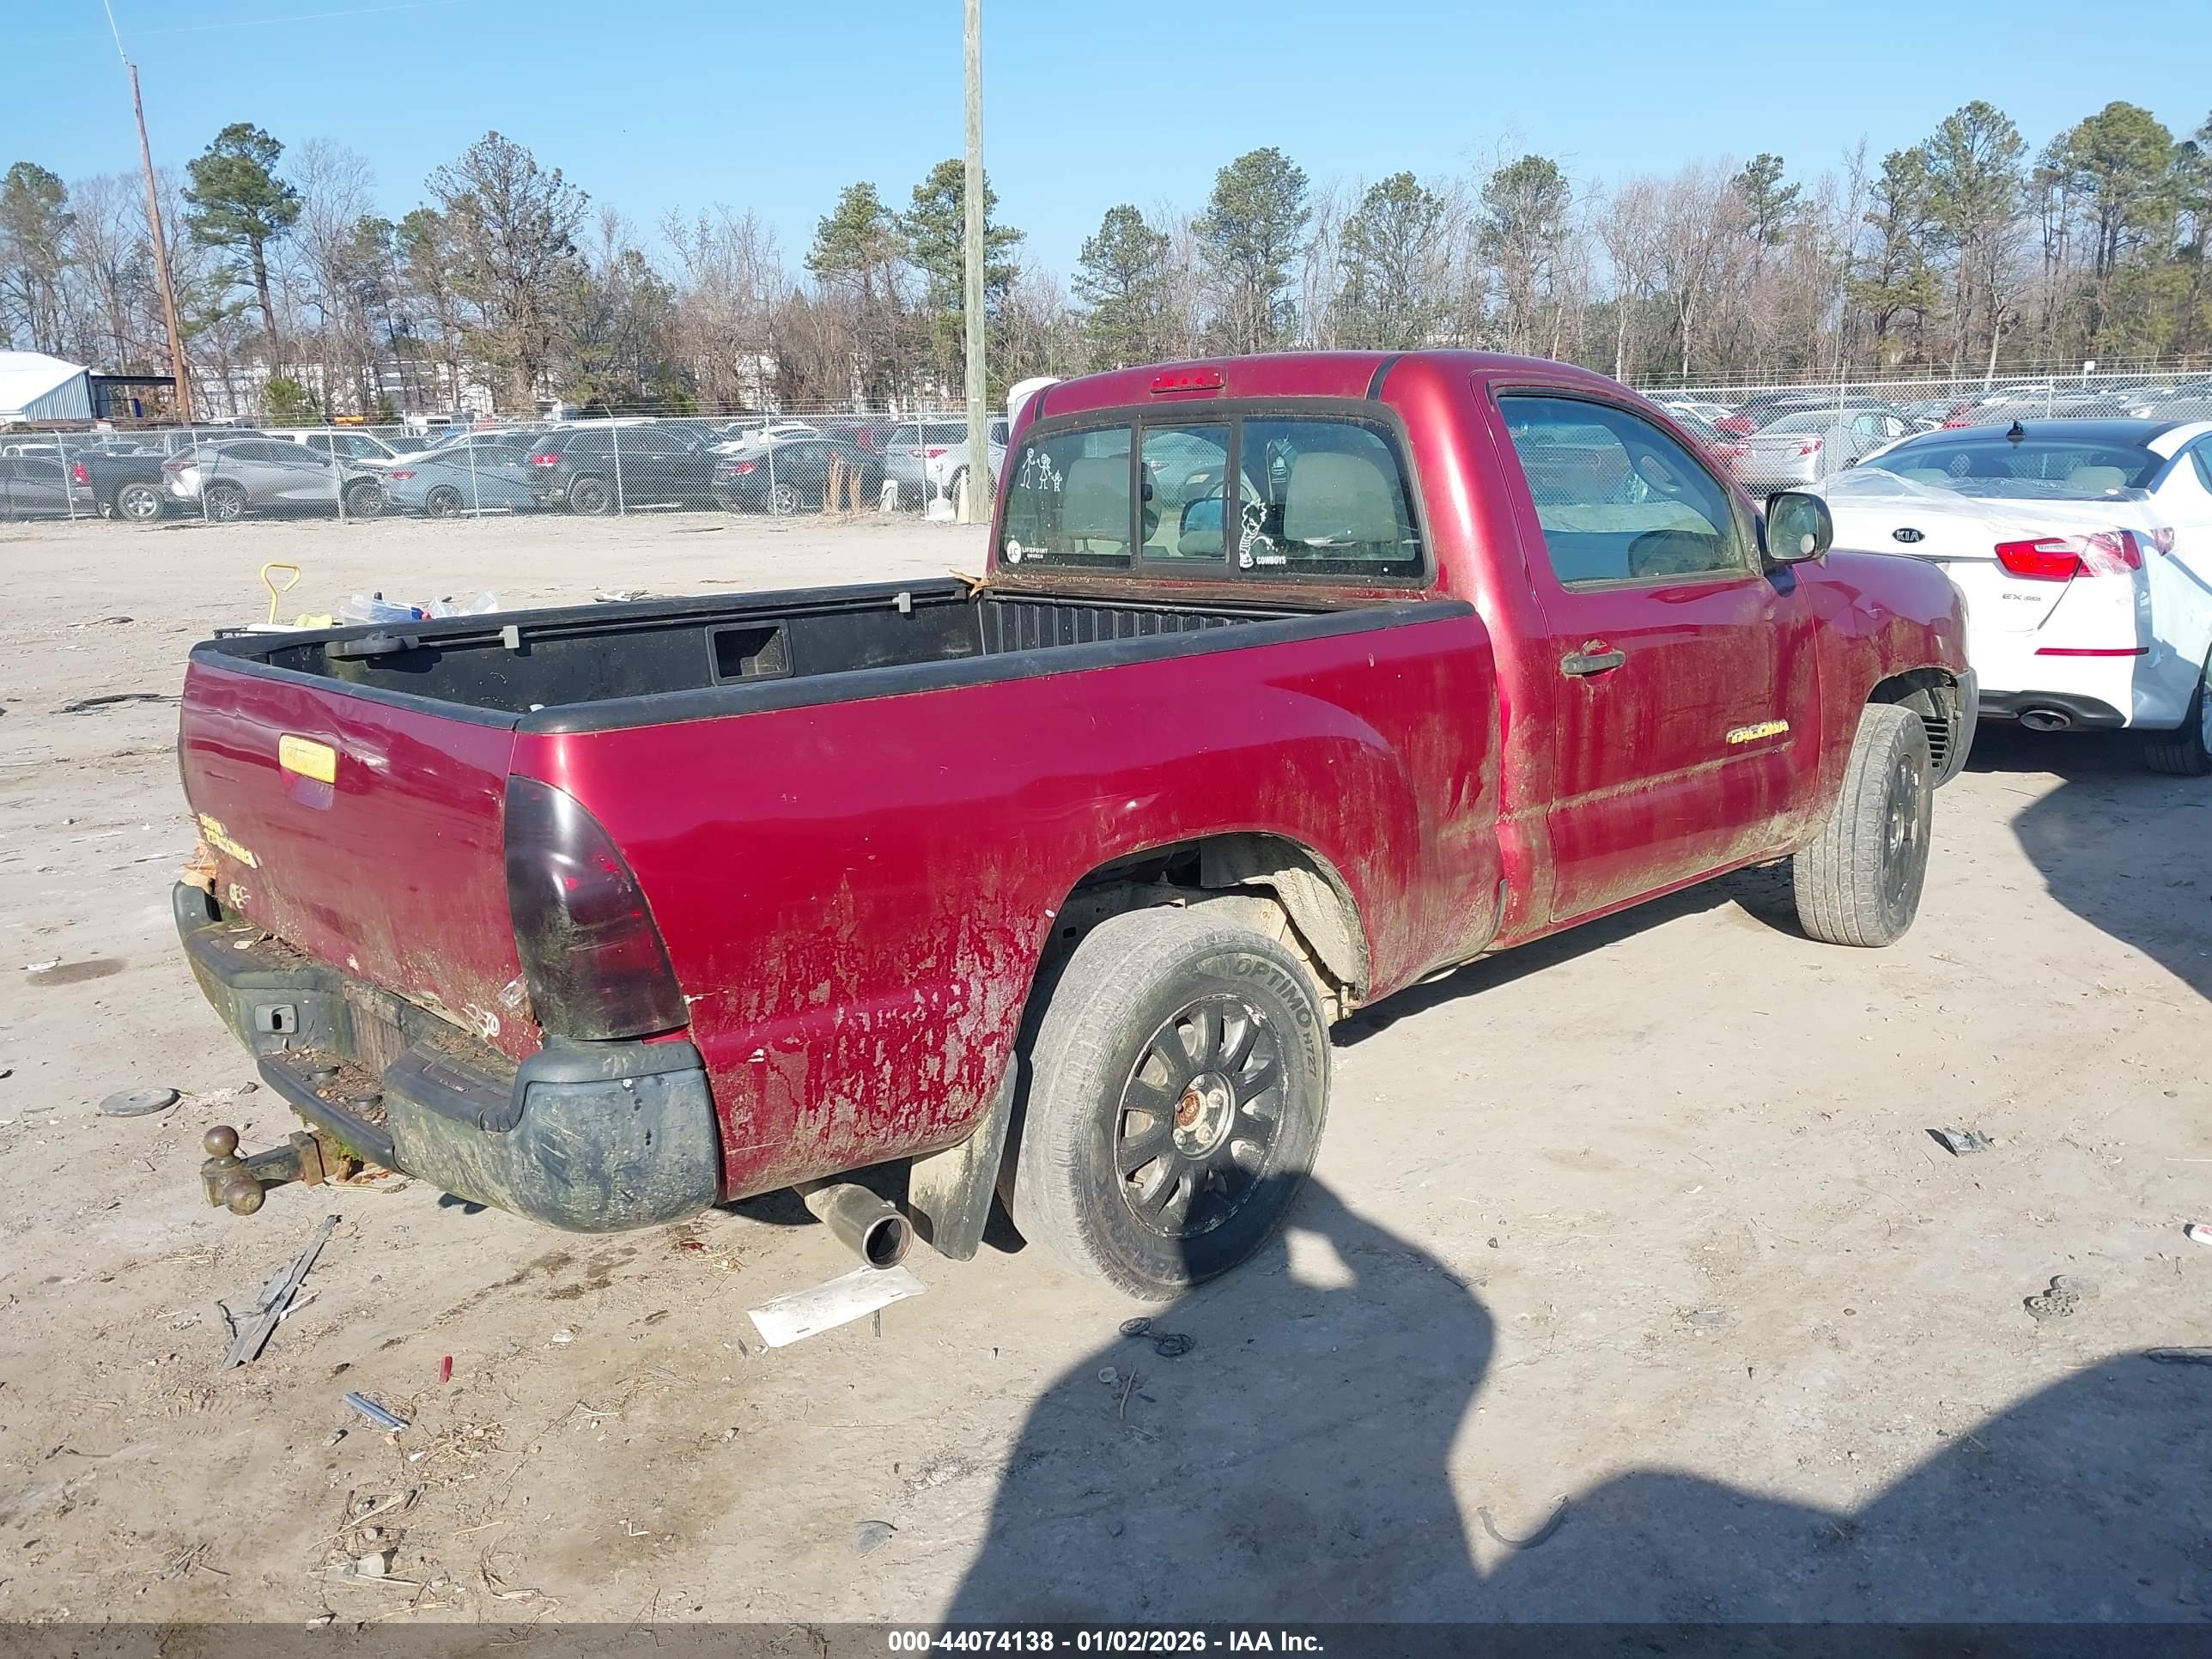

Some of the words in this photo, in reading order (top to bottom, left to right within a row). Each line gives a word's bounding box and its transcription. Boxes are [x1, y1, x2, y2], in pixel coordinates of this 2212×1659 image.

[1896, 530, 1920, 542] KIA
[1022, 546, 1048, 555] LIFEPOINT
[1255, 556, 1286, 566] COWBOYS
[1233, 957, 1312, 1029] OPTIMO
[1303, 1032, 1317, 1078] H727
